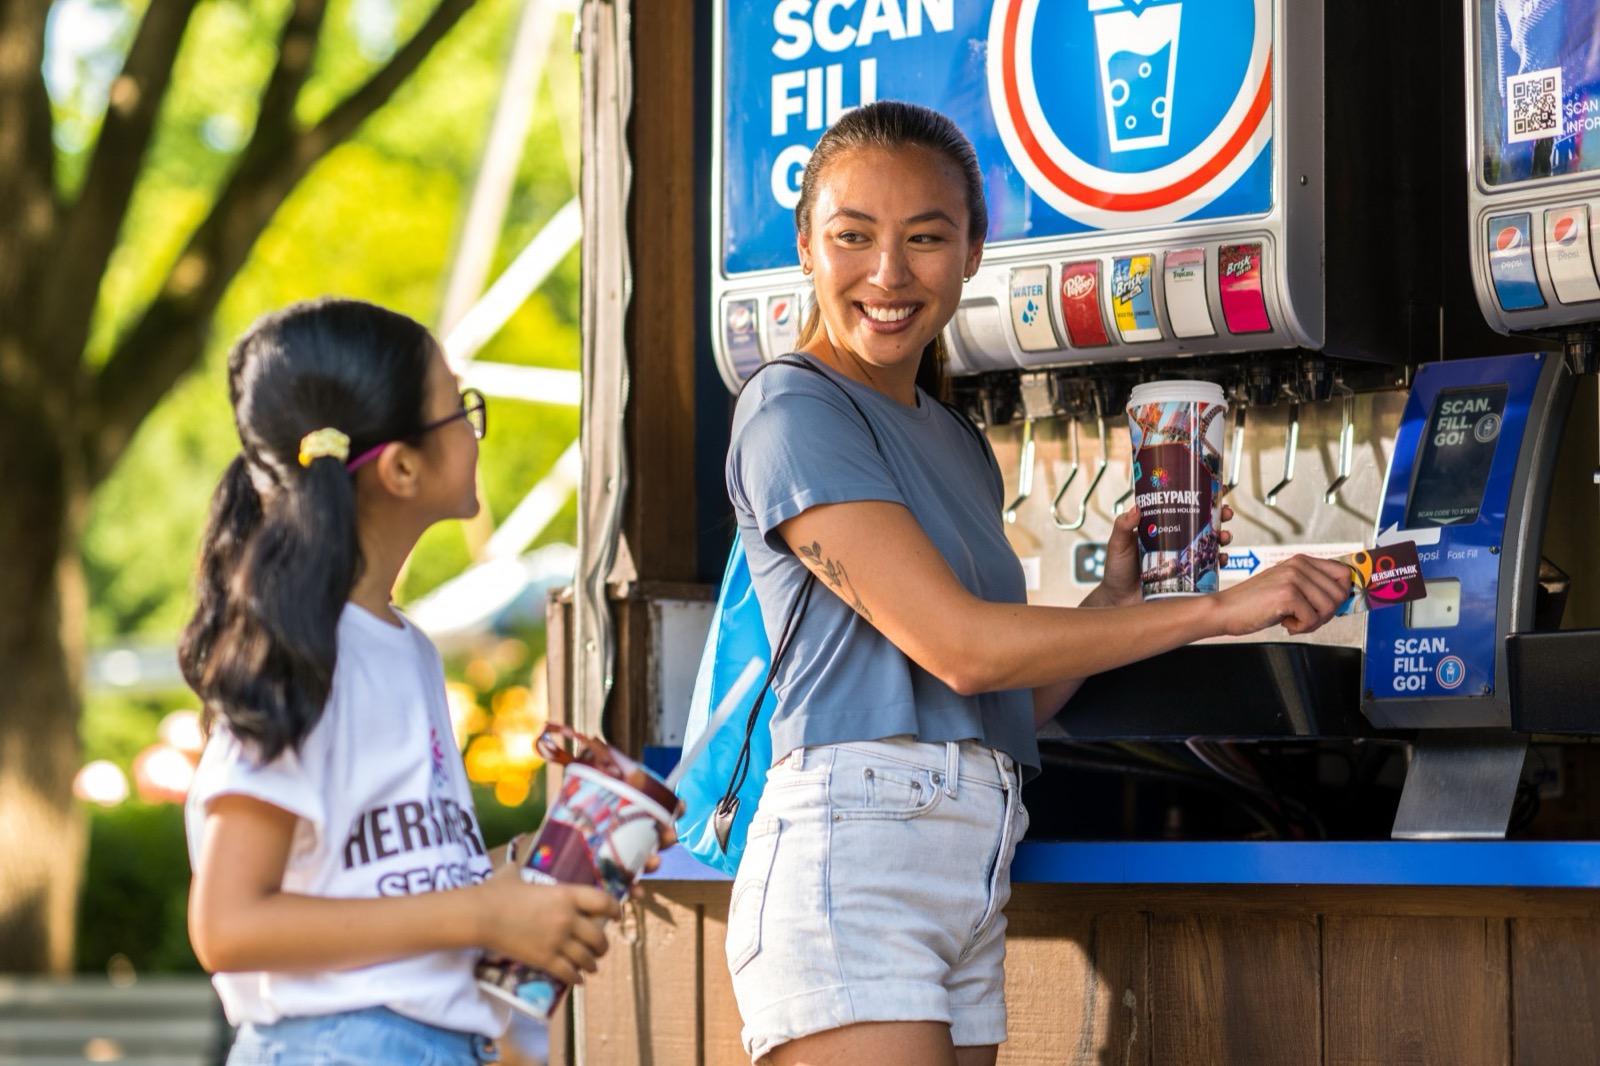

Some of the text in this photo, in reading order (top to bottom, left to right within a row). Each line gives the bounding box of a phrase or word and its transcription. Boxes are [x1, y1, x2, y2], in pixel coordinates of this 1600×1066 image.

[771, 0, 954, 60] SCAN
[1566, 99, 1598, 117] SCAN
[1226, 255, 1252, 277] Brisk
[1501, 259, 1523, 269] pepsi
[1013, 284, 1043, 298] WATER
[1115, 272, 1143, 298] Brisk
[1440, 398, 1491, 415] SCAN.
[1437, 416, 1473, 431] FILL.
[1434, 431, 1465, 447] GO!
[1460, 507, 1479, 515] START
[1158, 524, 1181, 534] pepsi
[1225, 557, 1255, 569] ALVES
[1417, 549, 1479, 563] epsi Fast Fill
[1371, 564, 1418, 582] HERSHEYPARK
[1394, 637, 1450, 655] SCAN.
[1394, 656, 1433, 673] FILL.
[1393, 675, 1426, 691] GO!
